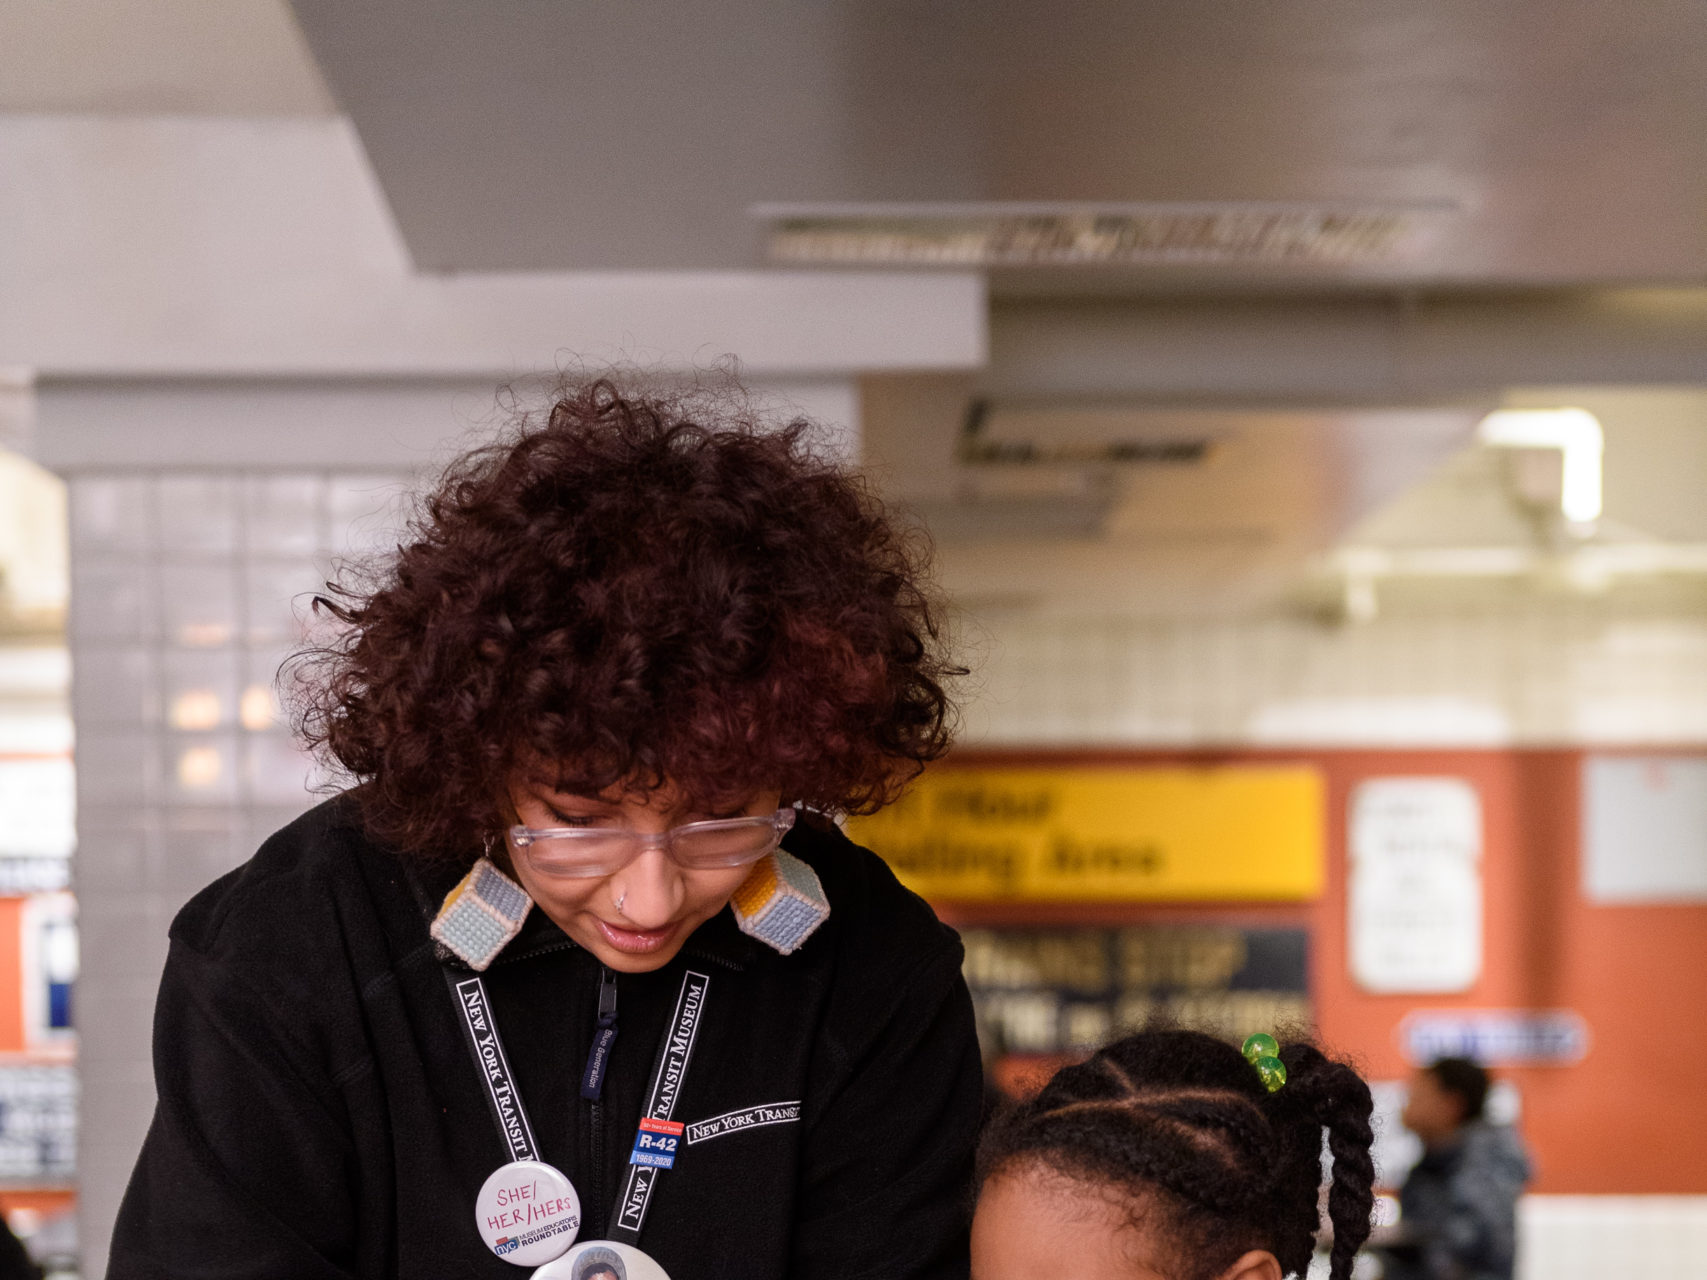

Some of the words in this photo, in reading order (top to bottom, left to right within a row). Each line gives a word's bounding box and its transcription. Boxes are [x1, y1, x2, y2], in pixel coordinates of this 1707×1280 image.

[464, 990, 487, 1031] NEW
[479, 1033, 502, 1082] YORK
[495, 1081, 528, 1152] TRANSIT
[625, 1177, 648, 1219] NEW
[670, 984, 702, 1056] MUSEUM
[693, 1122, 720, 1139] NEW
[721, 1113, 755, 1130] YORK
[639, 1134, 677, 1152] R-42
[636, 1154, 672, 1167] 1969-2020
[497, 1180, 536, 1206] SHE/
[521, 1220, 580, 1247] ROUNDTABLE
